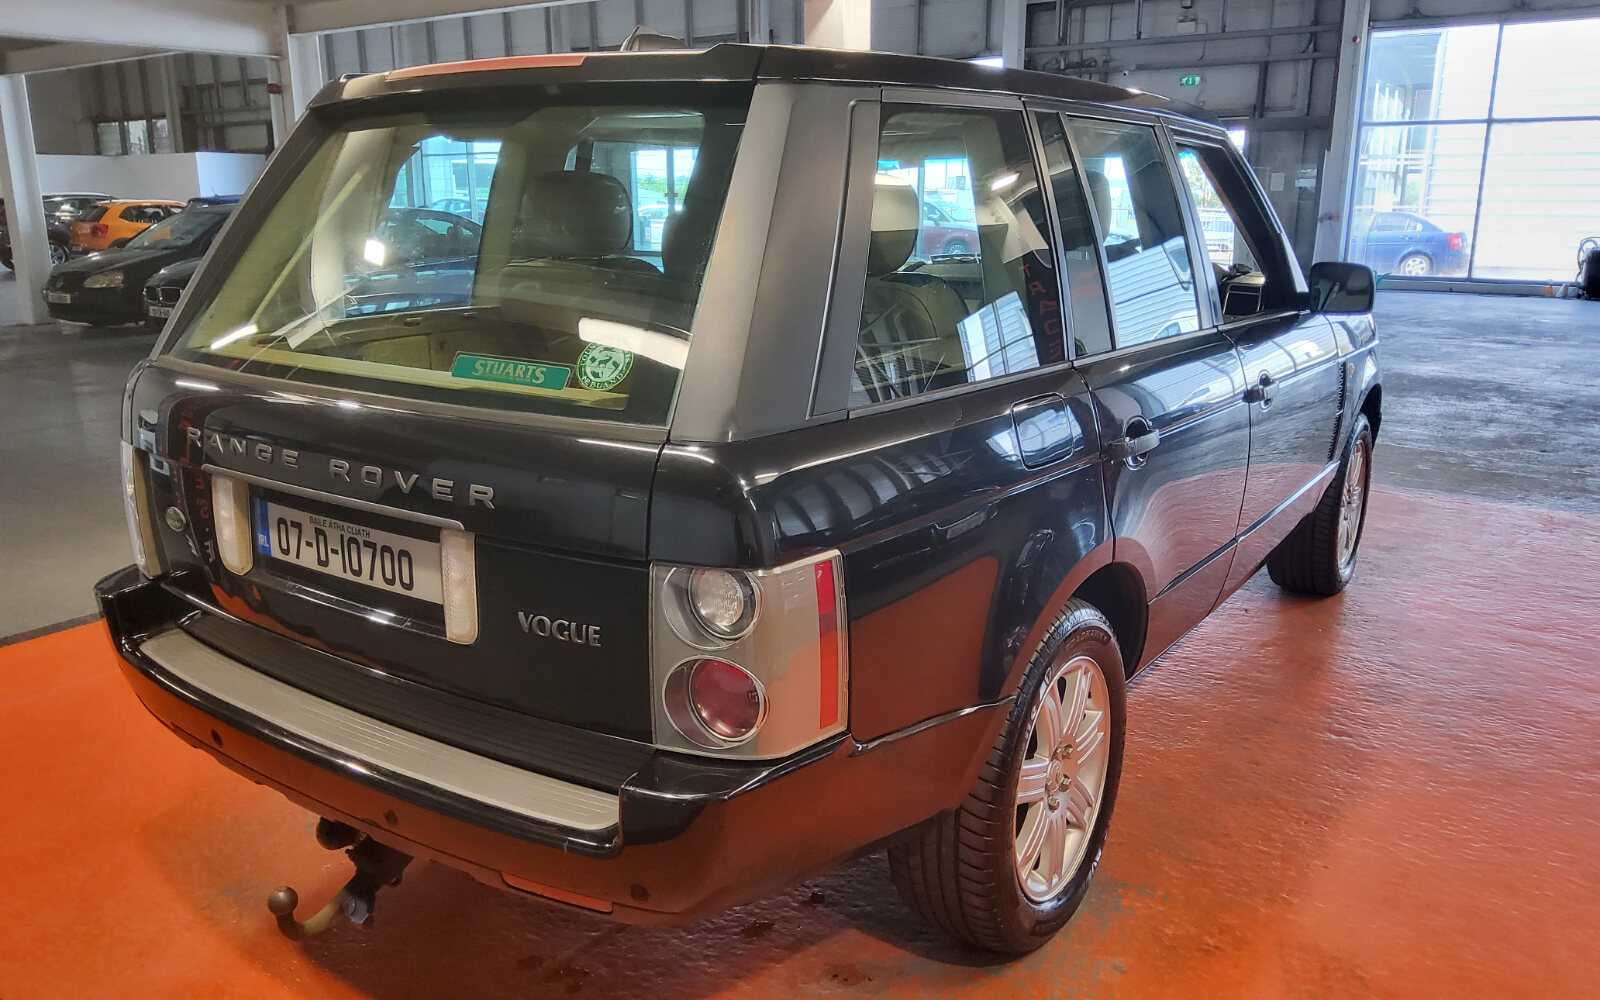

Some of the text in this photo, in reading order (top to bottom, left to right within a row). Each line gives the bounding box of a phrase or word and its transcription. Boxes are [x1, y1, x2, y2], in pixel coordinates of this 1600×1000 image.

[471, 360, 547, 384] STUARTS
[186, 426, 496, 510] RANGE ROVER
[309, 515, 327, 528] BAILE
[346, 525, 371, 539] CLIATH
[277, 516, 414, 591] 07-D-10700
[517, 611, 602, 648] VOGUE
